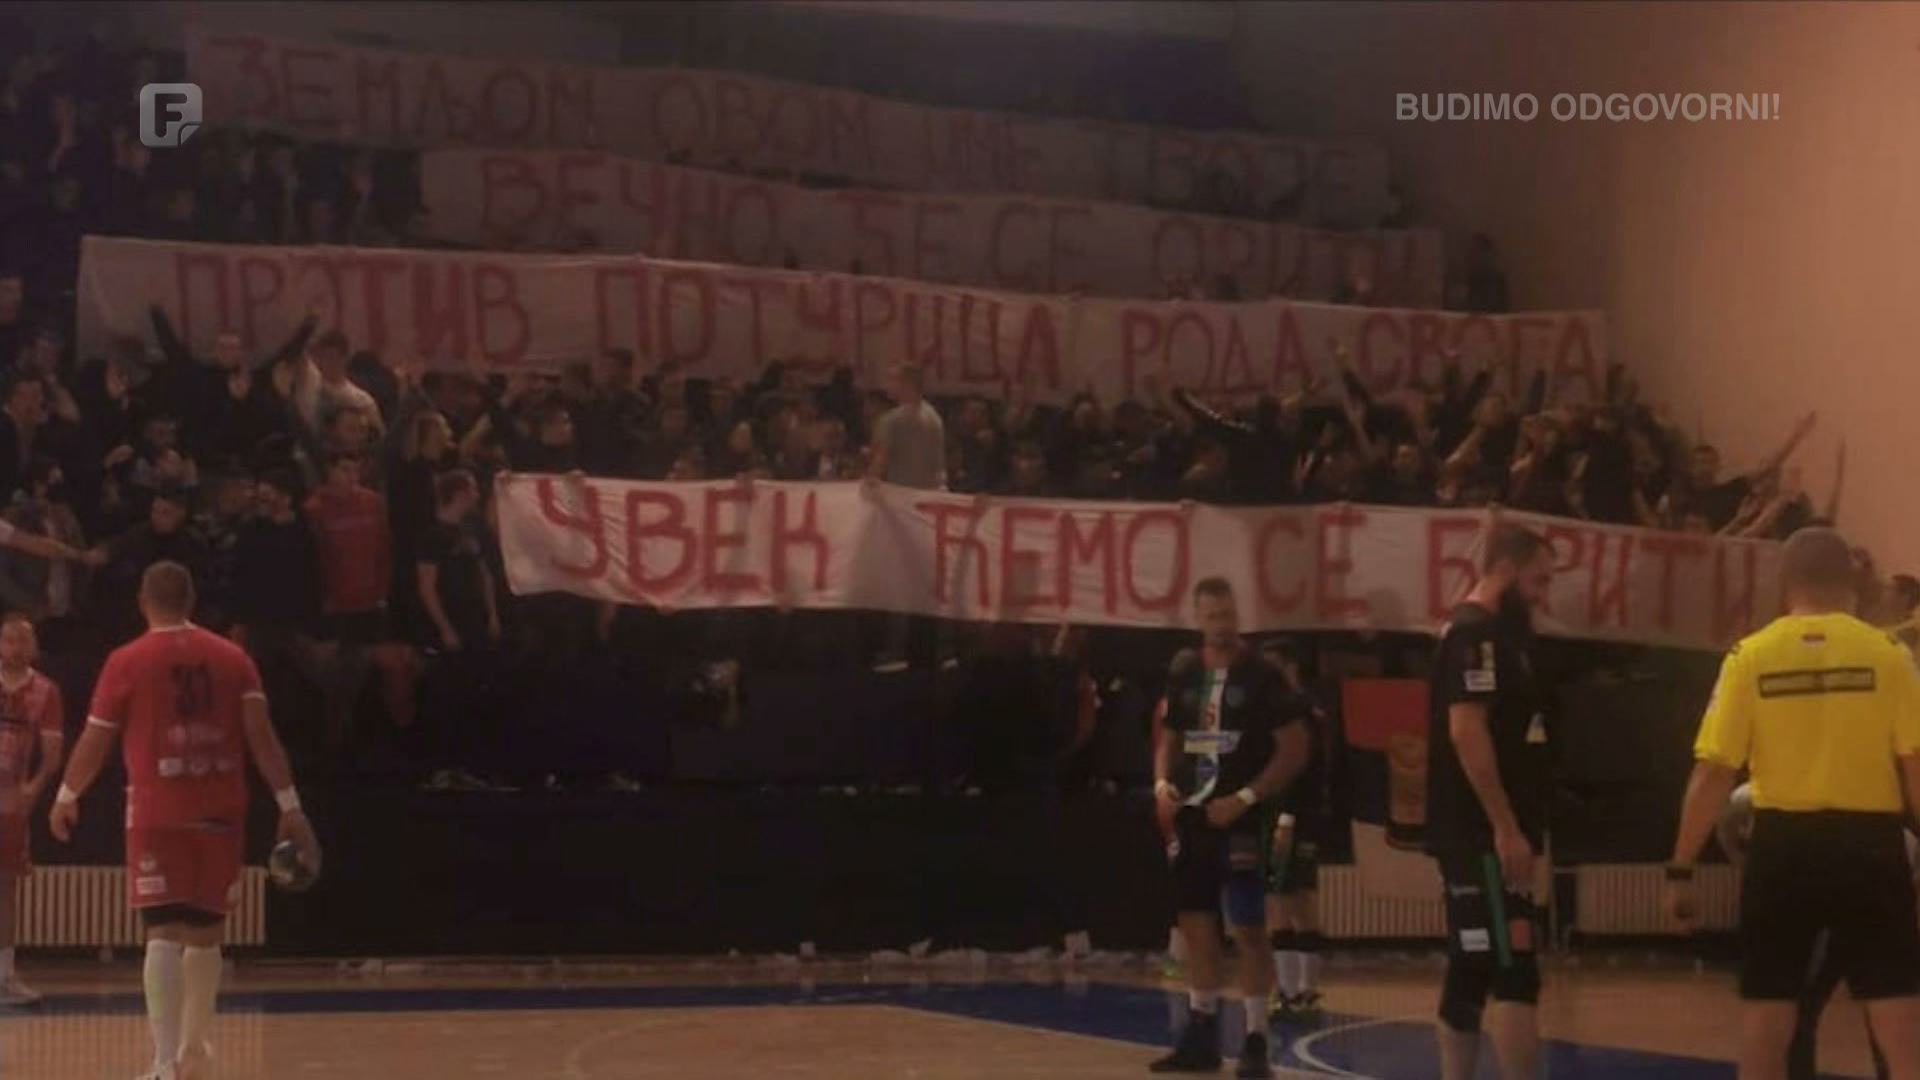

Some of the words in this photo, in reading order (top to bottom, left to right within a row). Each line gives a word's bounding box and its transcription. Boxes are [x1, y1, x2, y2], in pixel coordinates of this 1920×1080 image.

[480, 155, 778, 264] ВЕЧНО
[985, 200, 1094, 294] СЕ
[177, 252, 530, 366] ПРОТИВ
[597, 266, 1060, 397] ПОТУРИЦА
[1120, 308, 1312, 398] РОДА
[1358, 311, 1604, 396] СВОГА
[538, 478, 828, 594] УВЕК
[914, 500, 1190, 614] ЋЕМО
[1255, 505, 1372, 622] СЕ
[1429, 518, 1758, 645] БРИТИ
